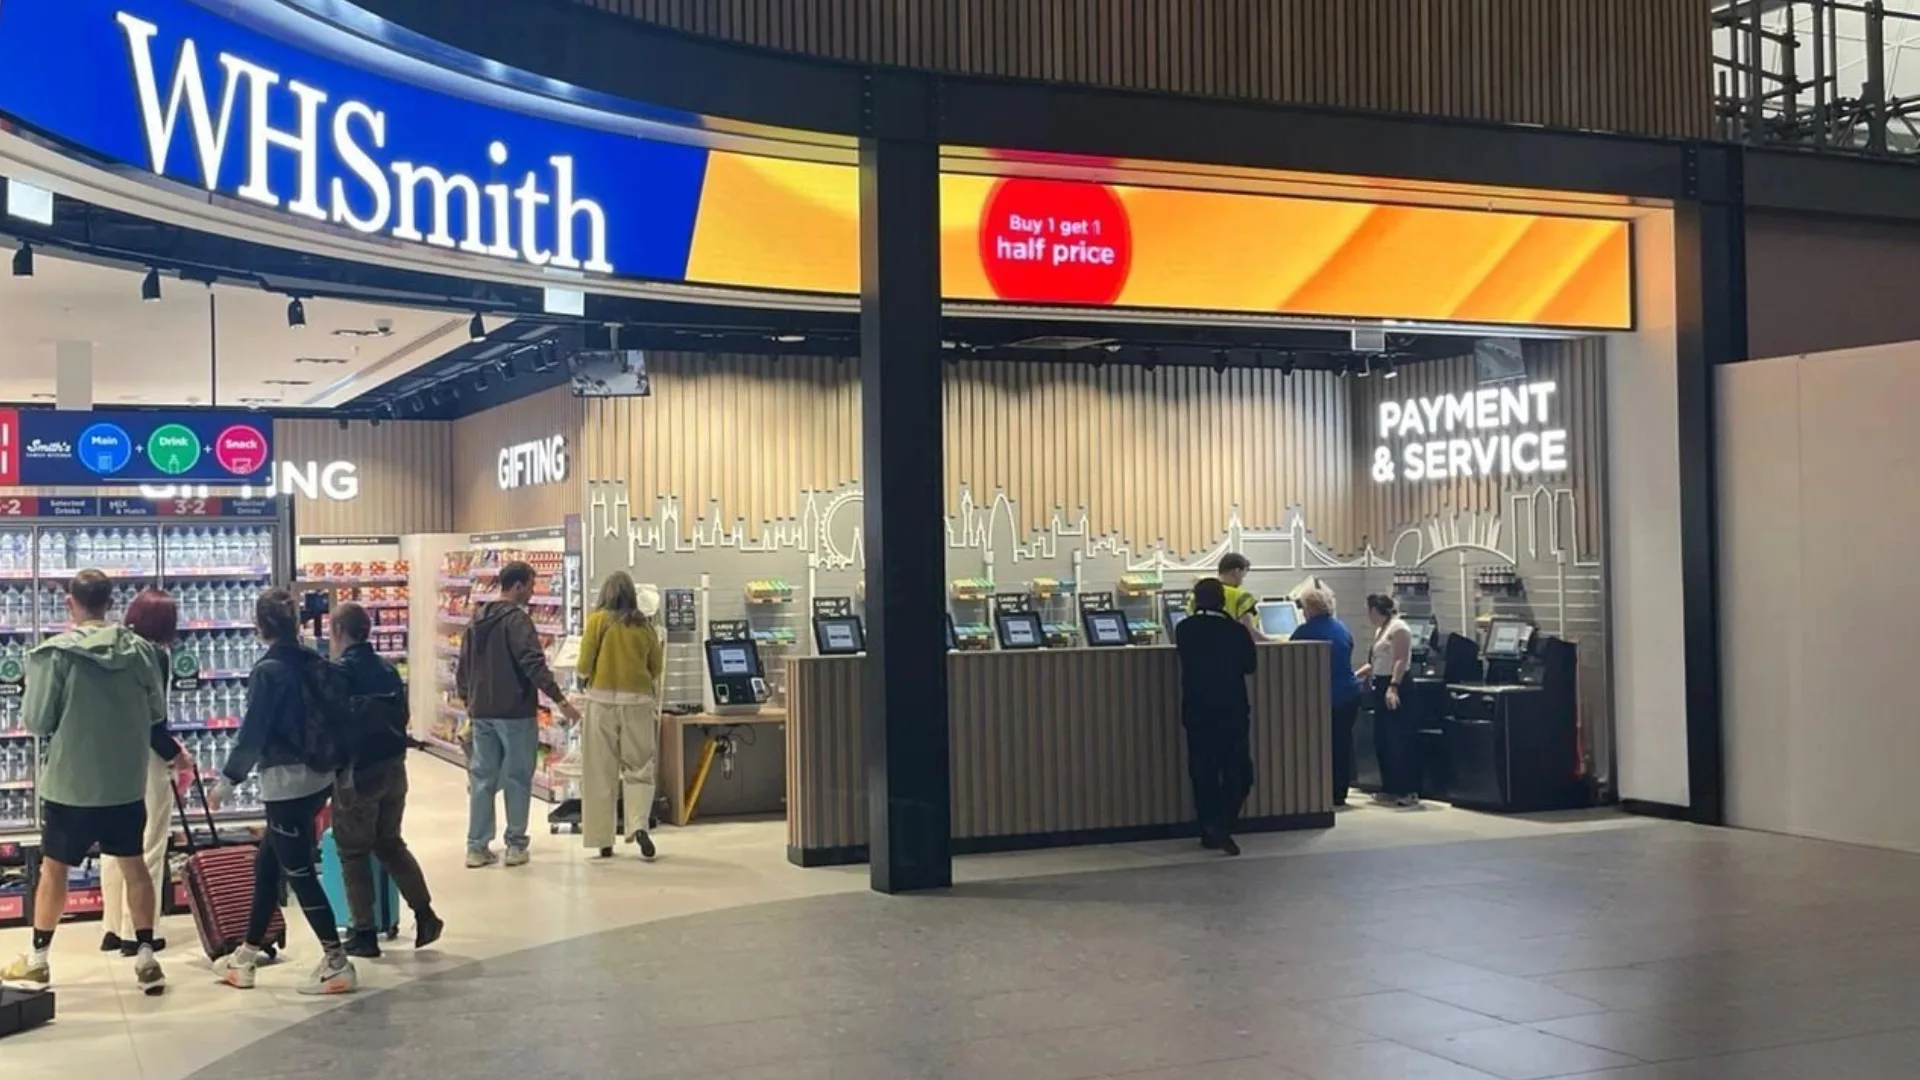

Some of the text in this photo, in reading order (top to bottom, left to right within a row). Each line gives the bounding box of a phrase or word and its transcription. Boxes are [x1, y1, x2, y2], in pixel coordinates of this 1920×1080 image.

[115, 10, 613, 273] WHSmith
[1009, 214, 1101, 236] Buy 1 get 1
[997, 235, 1115, 266] half price
[1379, 381, 1556, 439] PAYMENT
[91, 435, 118, 445] Main
[159, 436, 188, 446] Drink
[225, 438, 257, 449] Snack
[498, 433, 566, 490] GIFTING
[1372, 429, 1568, 483] & SERVICE
[175, 500, 206, 514] 3-2
